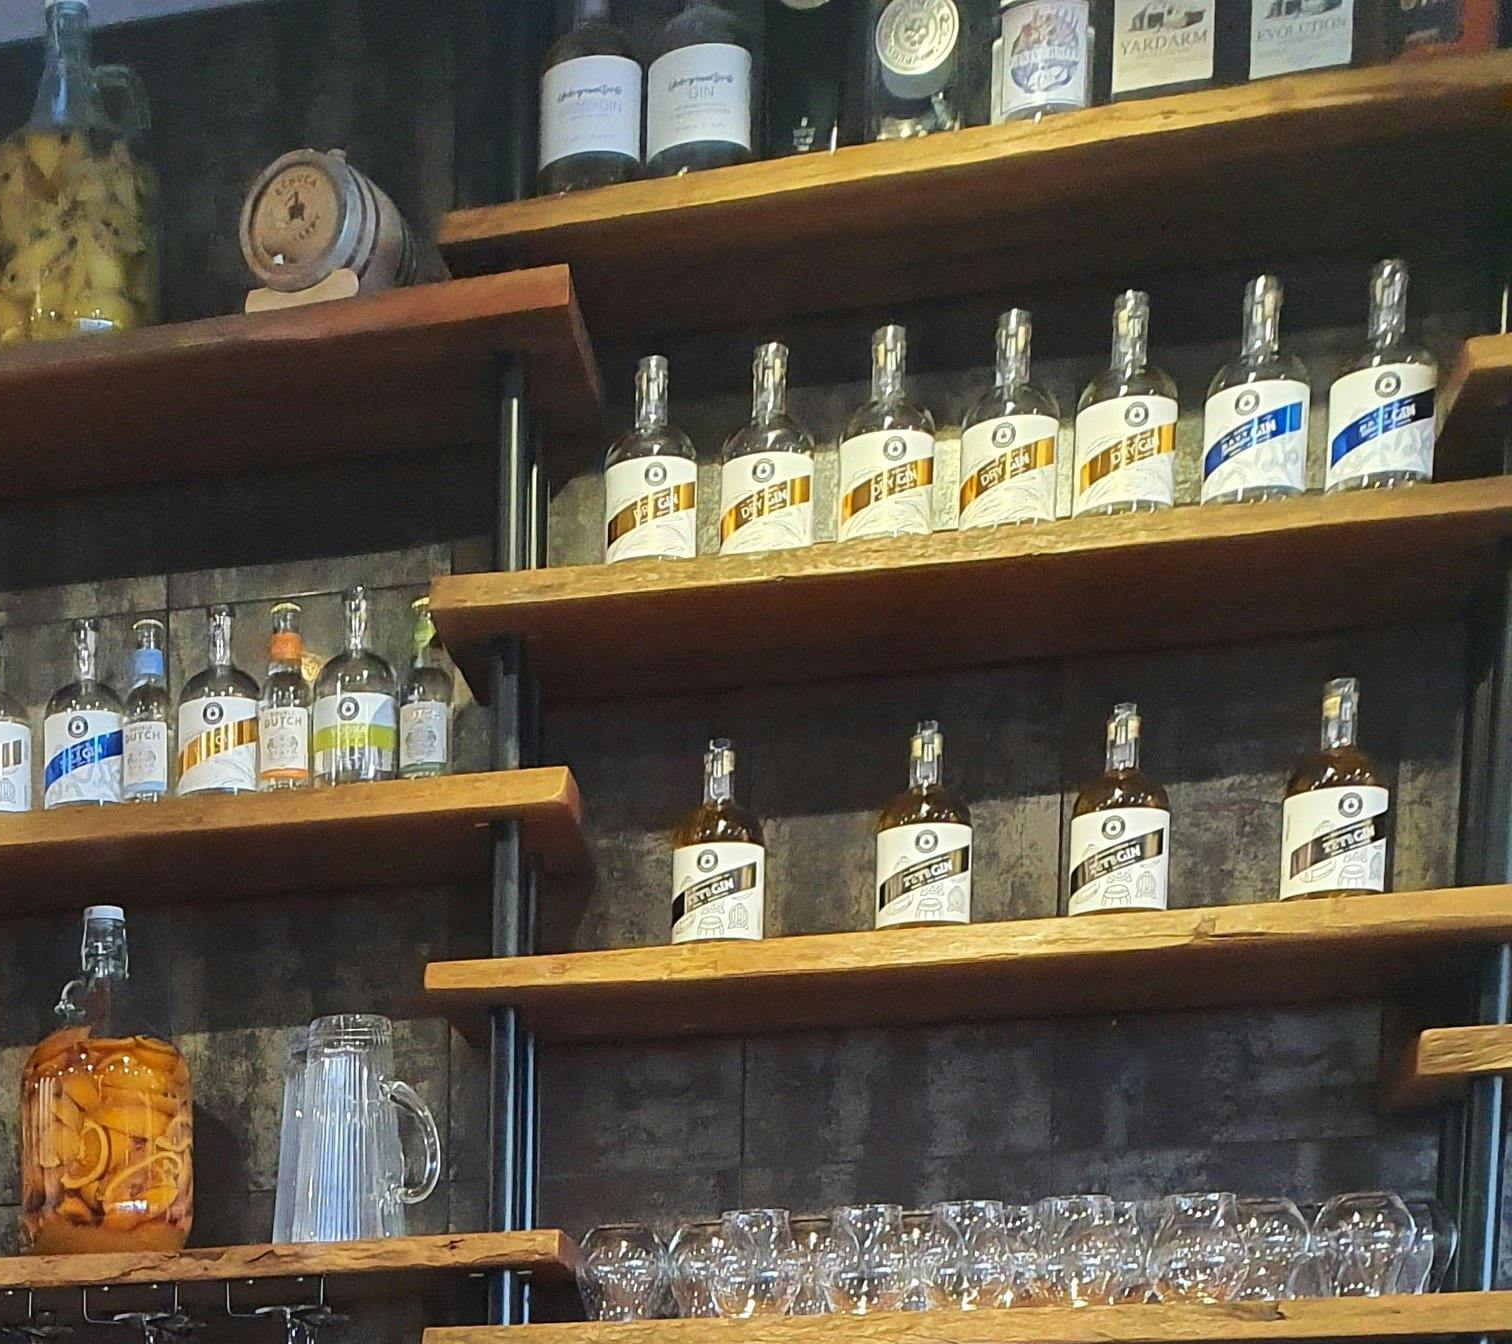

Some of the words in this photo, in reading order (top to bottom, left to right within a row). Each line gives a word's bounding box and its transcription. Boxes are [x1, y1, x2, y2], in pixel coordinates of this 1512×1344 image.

[1119, 30, 1208, 56] YARDARM
[689, 86, 714, 100] GIN
[1110, 444, 1136, 465] DY
[1138, 437, 1157, 452] GI
[897, 468, 919, 487] GIN
[980, 465, 1005, 487] DRY
[657, 493, 679, 510] GIN
[740, 497, 764, 520] DRY
[767, 489, 788, 508] GIN
[264, 716, 304, 729] DUTCH
[125, 731, 161, 744] DUTCH
[1353, 824, 1375, 842] GIN
[1116, 844, 1141, 863] GIN
[931, 860, 953, 876] GIN
[711, 877, 735, 894] GIN
